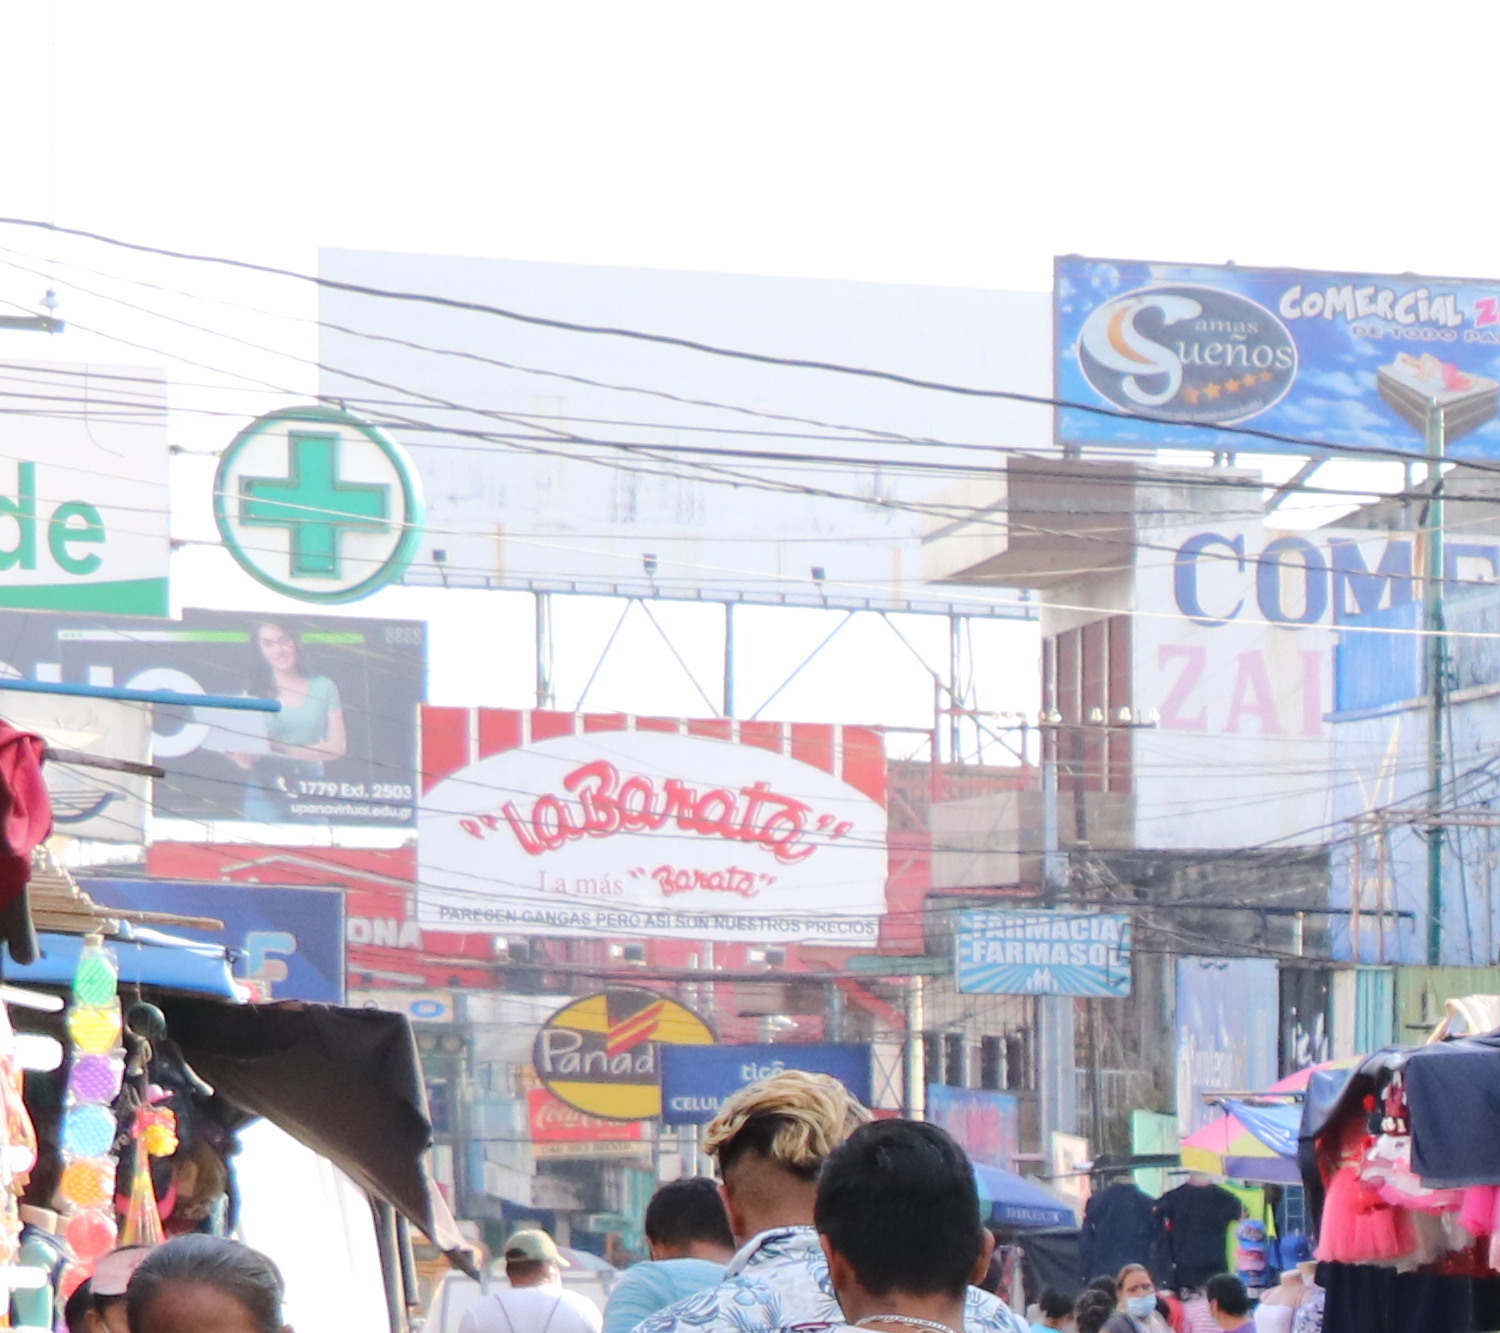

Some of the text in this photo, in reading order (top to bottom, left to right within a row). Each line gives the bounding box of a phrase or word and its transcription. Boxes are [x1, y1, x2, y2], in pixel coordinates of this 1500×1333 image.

[1279, 284, 1463, 328] COMERCIAL
[1352, 325, 1383, 338] DE
[1390, 327, 1457, 342] TODO
[300, 782, 337, 797] 1779
[374, 785, 412, 799] 2503
[576, 869, 624, 895] más
[439, 906, 517, 922] PARECEN
[522, 909, 591, 927] GANGAS
[595, 912, 640, 928] PERO
[675, 914, 711, 929] SON
[713, 914, 801, 932] NUESTROS
[804, 918, 877, 935] PRECIOS
[972, 914, 1120, 941] FARMACIA
[972, 941, 1121, 967] FARMASOL
[1006, 1206, 1062, 1223] DIRECT
